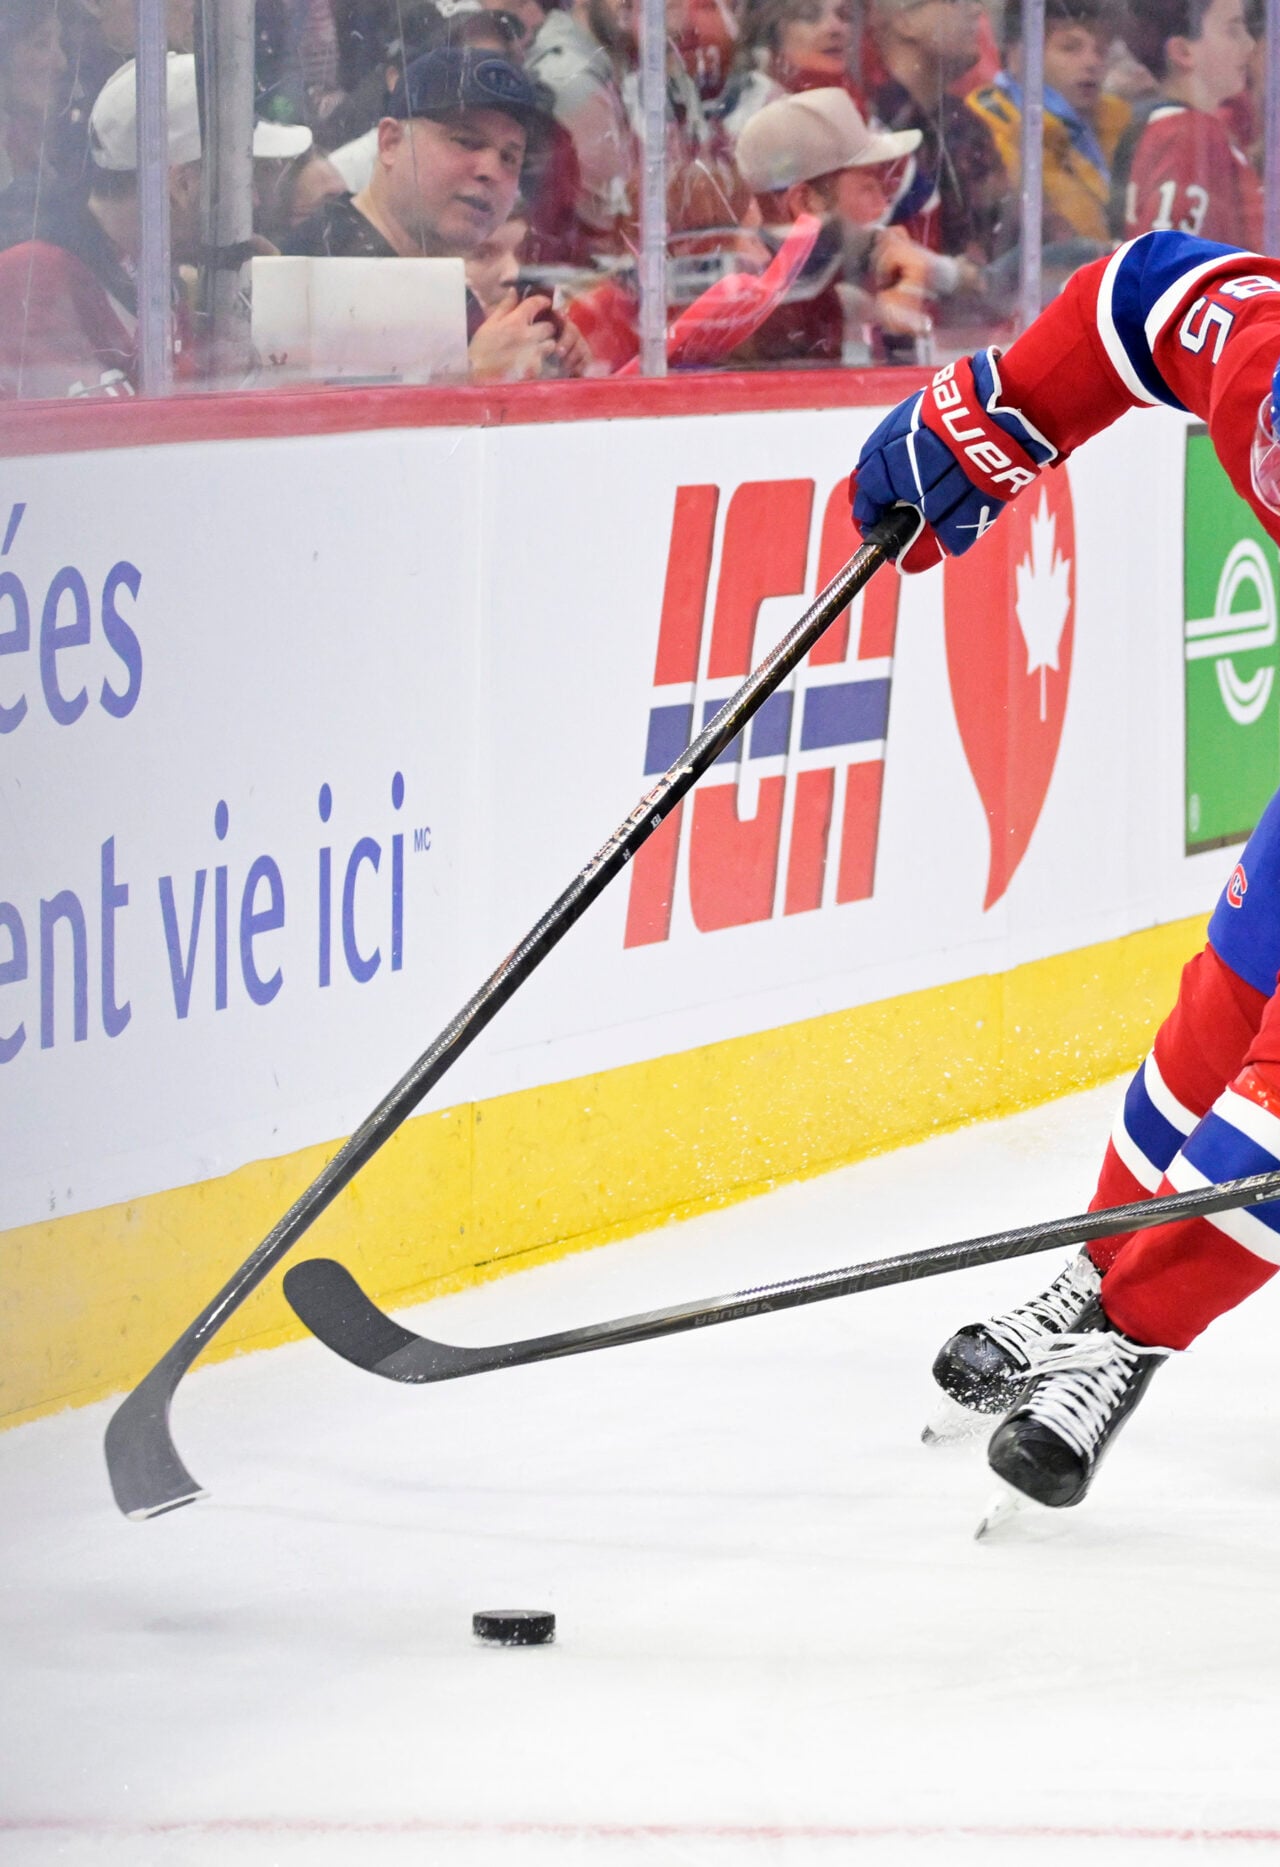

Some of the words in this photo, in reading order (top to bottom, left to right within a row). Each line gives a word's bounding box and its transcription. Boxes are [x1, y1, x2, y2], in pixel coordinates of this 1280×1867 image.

[1152, 180, 1209, 236] 13
[158, 800, 286, 1020] vie
[318, 770, 405, 988] ici
[413, 826, 432, 853] MC
